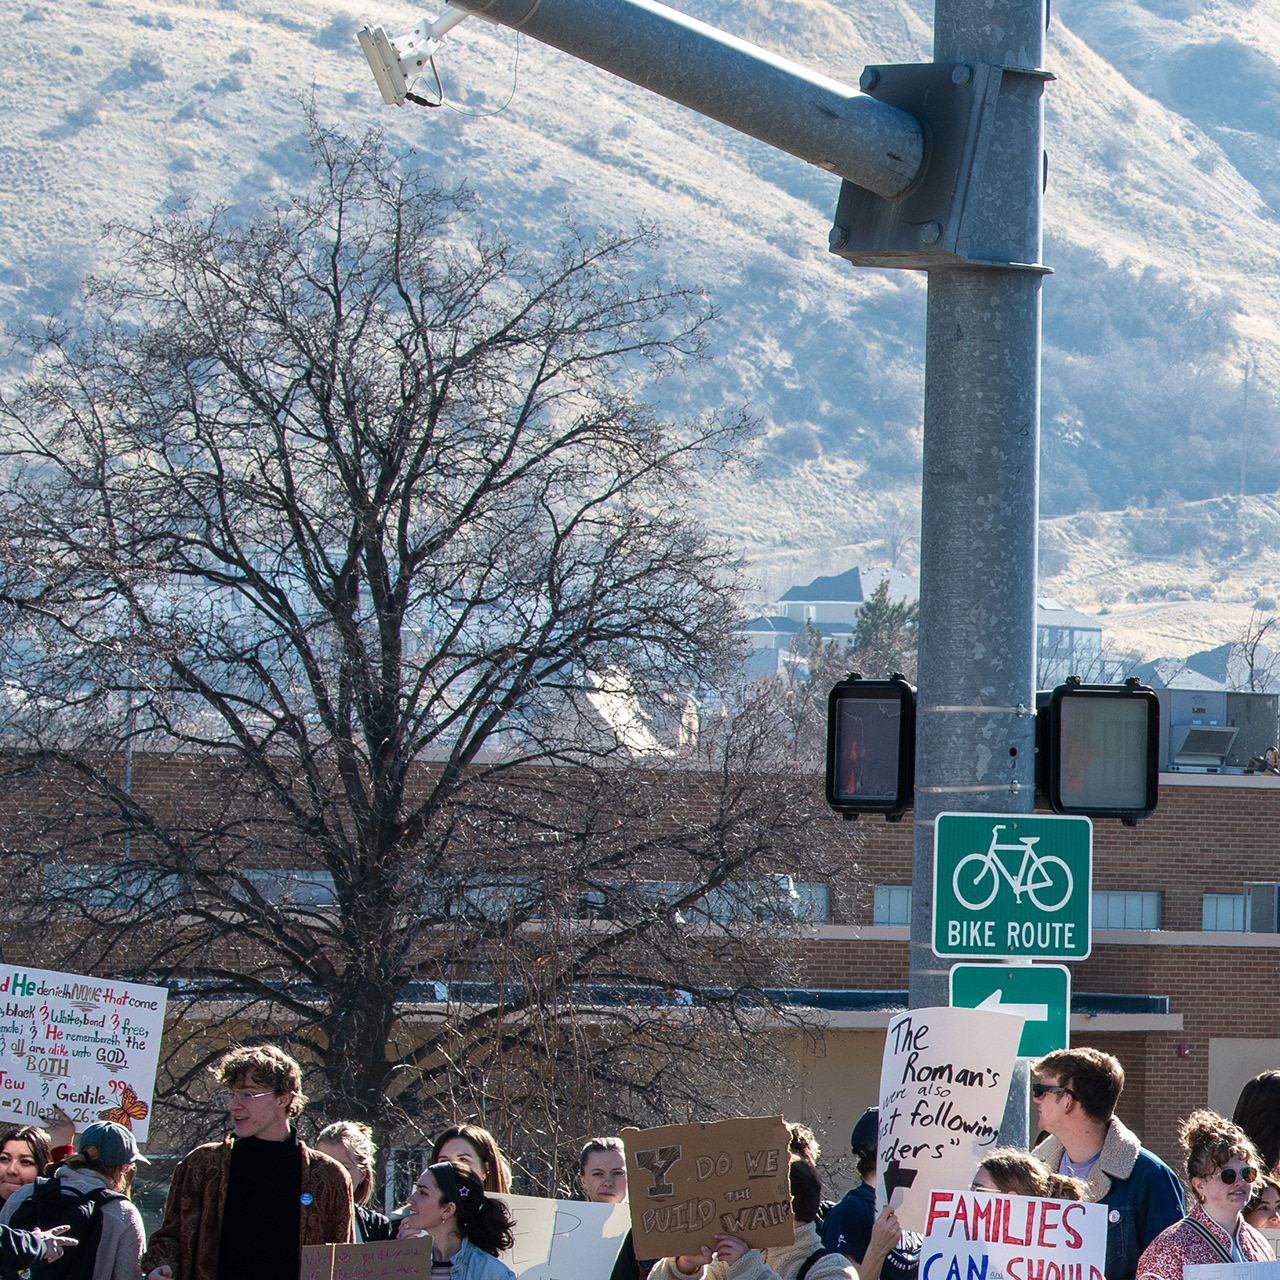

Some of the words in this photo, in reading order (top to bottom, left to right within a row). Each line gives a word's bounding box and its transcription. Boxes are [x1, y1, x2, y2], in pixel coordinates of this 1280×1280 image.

[948, 920, 996, 947] BIKE
[1007, 921, 1076, 949] ROUTE
[11, 973, 36, 996] He
[37, 980, 71, 999] denieth
[71, 983, 102, 1003] NONE
[102, 988, 130, 1006] that
[129, 997, 158, 1011] come
[45, 1024, 63, 1040] He
[66, 1031, 120, 1046] remembereth
[126, 1036, 146, 1050] the
[121, 1018, 149, 1038] free,
[891, 1016, 929, 1055] The
[11, 1039, 25, 1051] all
[29, 1045, 46, 1054] are
[48, 1043, 69, 1057] alike
[72, 1046, 92, 1058] unto
[96, 1048, 128, 1067] GOD,
[26, 1055, 70, 1076] BOTH
[0, 1071, 25, 1090] Jew
[902, 1051, 1000, 1088] Roman's
[882, 1088, 908, 1111] were
[918, 1082, 952, 1098] also
[910, 1099, 999, 1147] following
[634, 1145, 682, 1198] Y
[694, 1152, 732, 1182] DO
[744, 1149, 780, 1173] WE
[724, 1187, 752, 1202] THE
[641, 1197, 716, 1236] BUILD
[925, 1192, 1086, 1249] FAMILIES
[989, 1270, 1004, 1280] and
